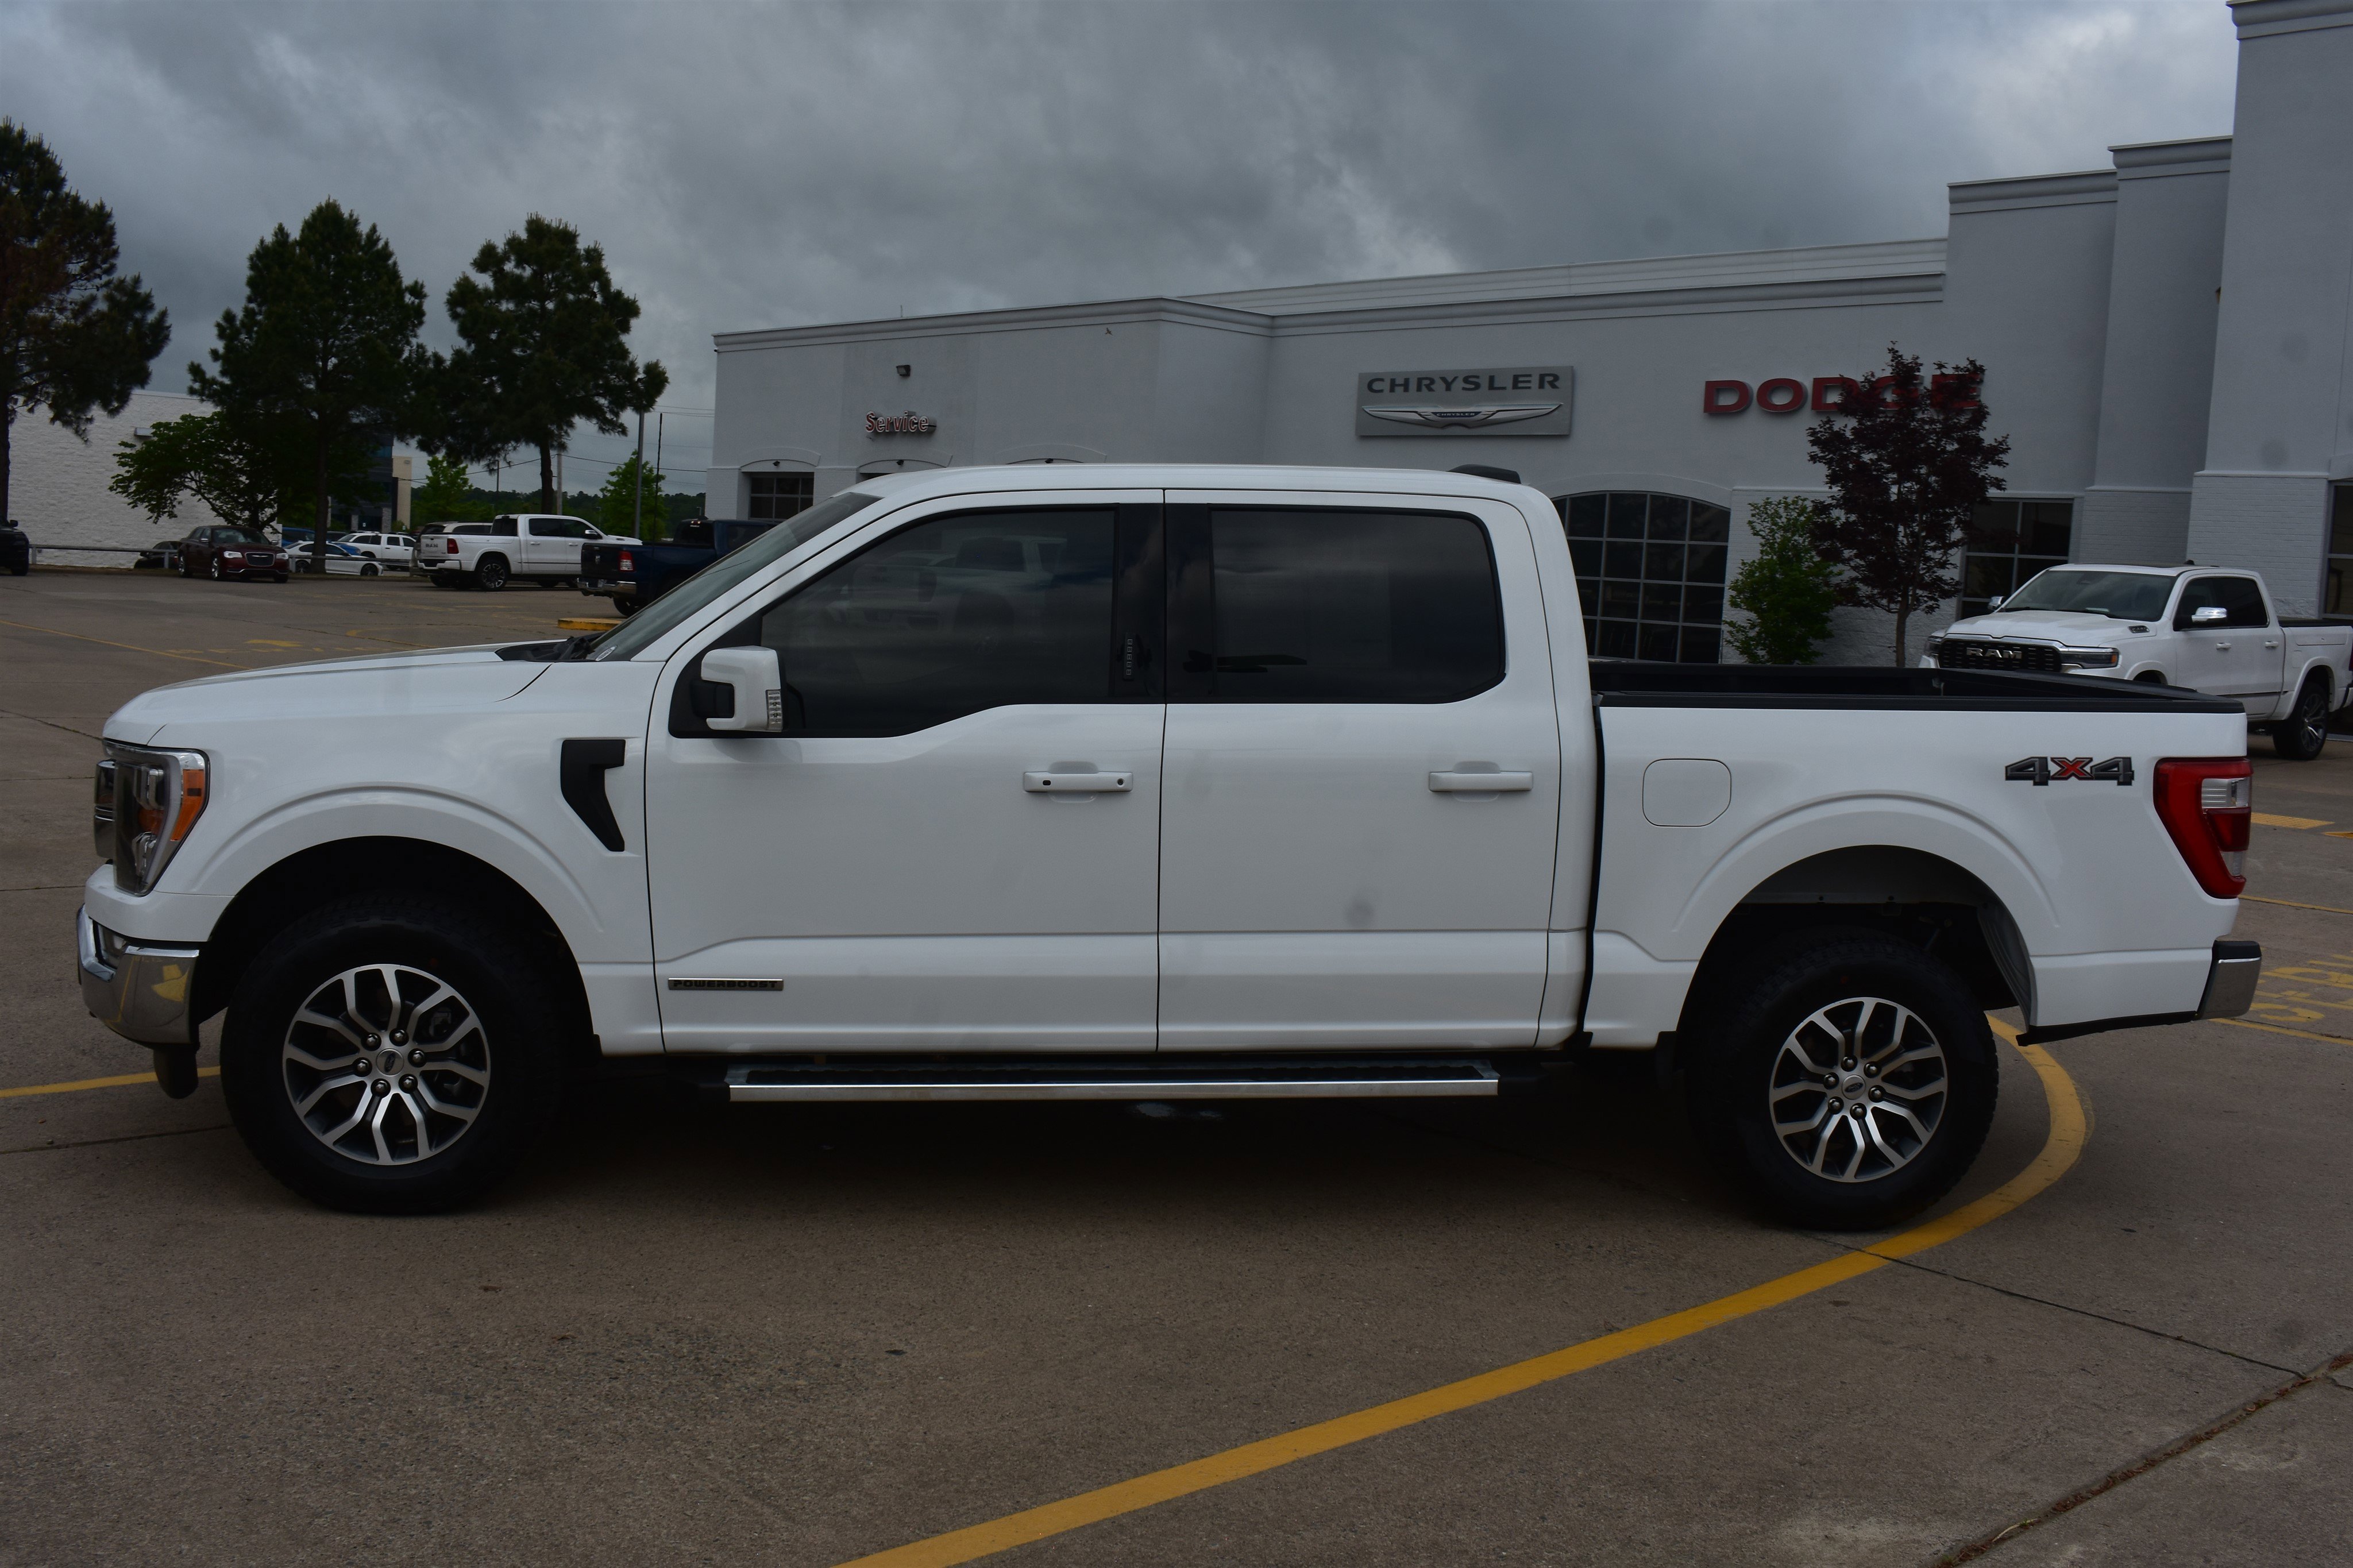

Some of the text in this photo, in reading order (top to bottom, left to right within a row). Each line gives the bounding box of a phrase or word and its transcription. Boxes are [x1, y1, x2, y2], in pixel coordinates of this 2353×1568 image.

[1366, 373, 1560, 393] CHRYSLER
[865, 411, 929, 432] Service
[1966, 647, 2022, 659] RAM
[673, 979, 778, 988] POWERBOOST
